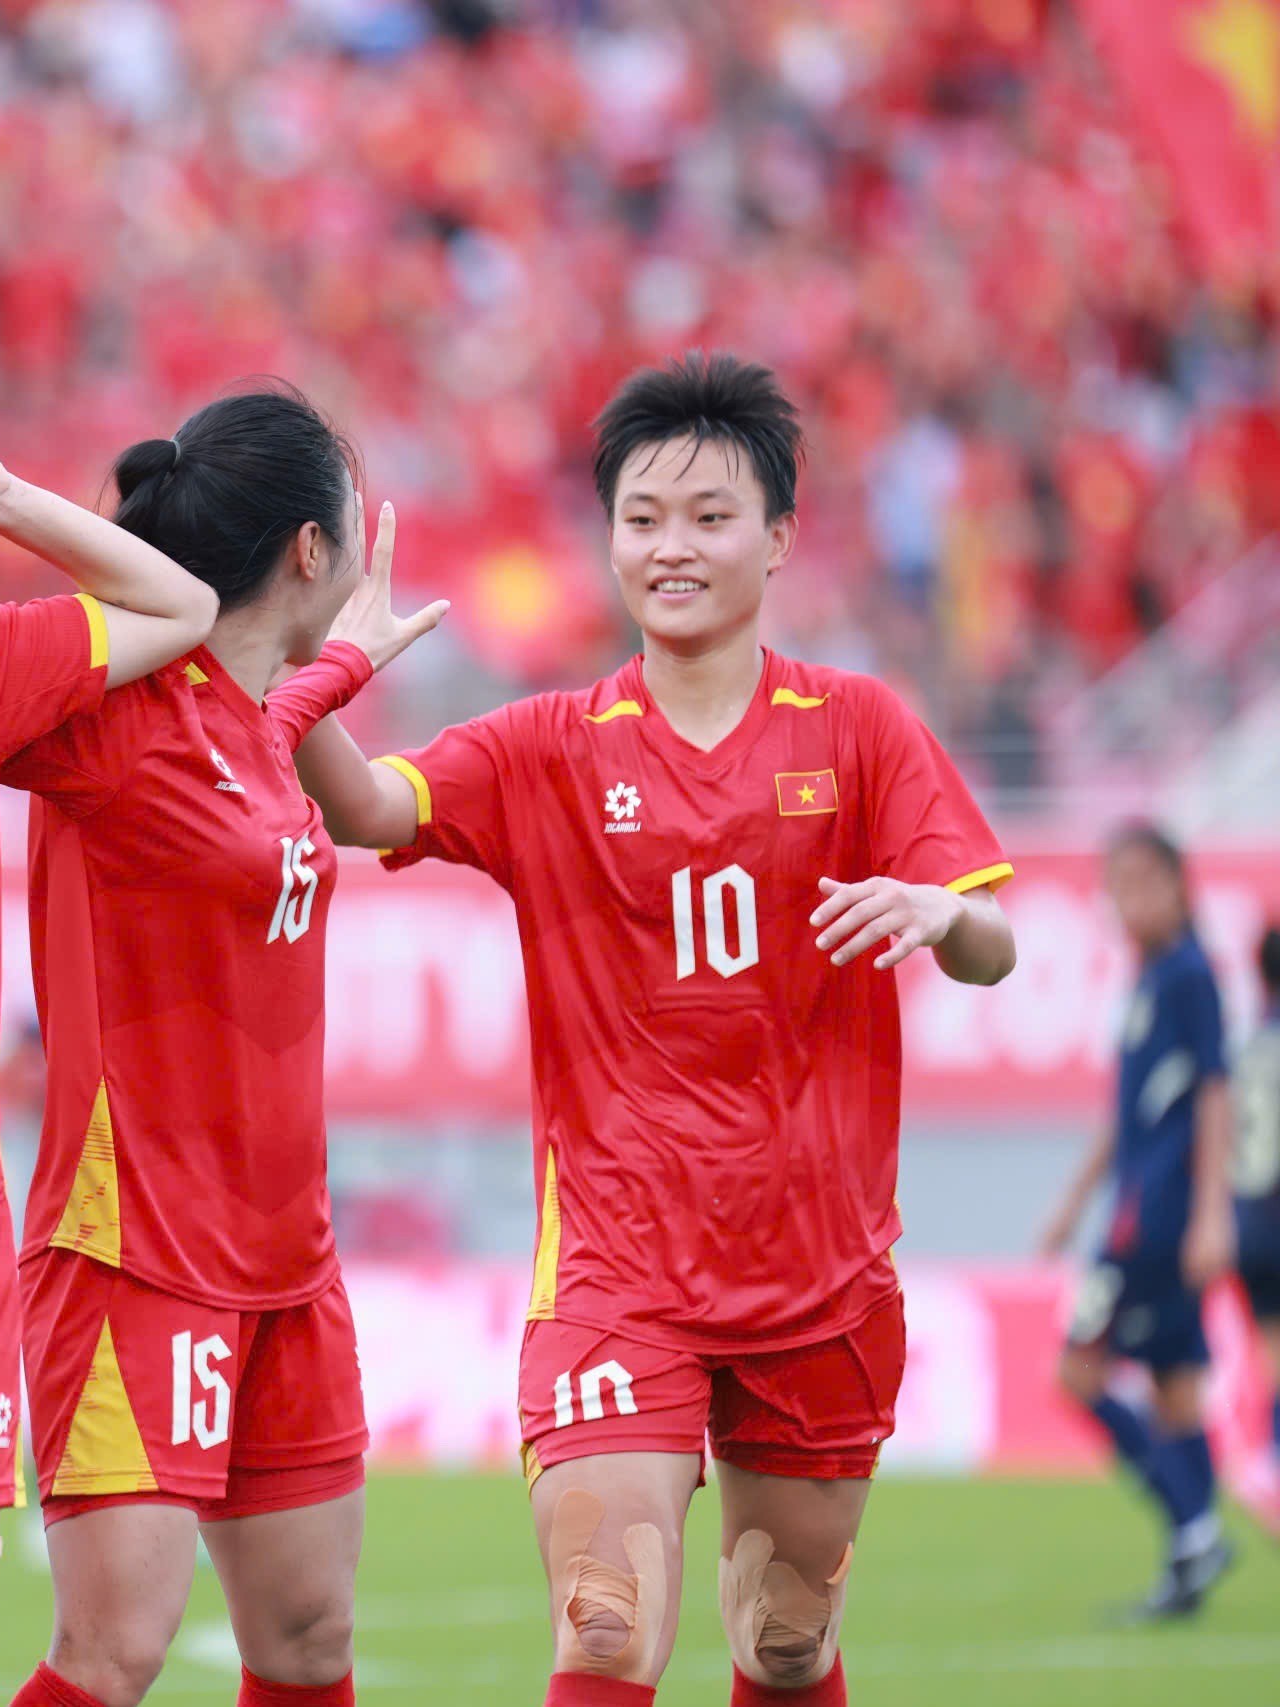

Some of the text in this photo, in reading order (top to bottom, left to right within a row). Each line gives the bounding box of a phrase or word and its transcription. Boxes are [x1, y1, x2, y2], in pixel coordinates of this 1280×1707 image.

[266, 831, 319, 945] 15
[672, 863, 759, 981] 10
[171, 1329, 233, 1451] 15
